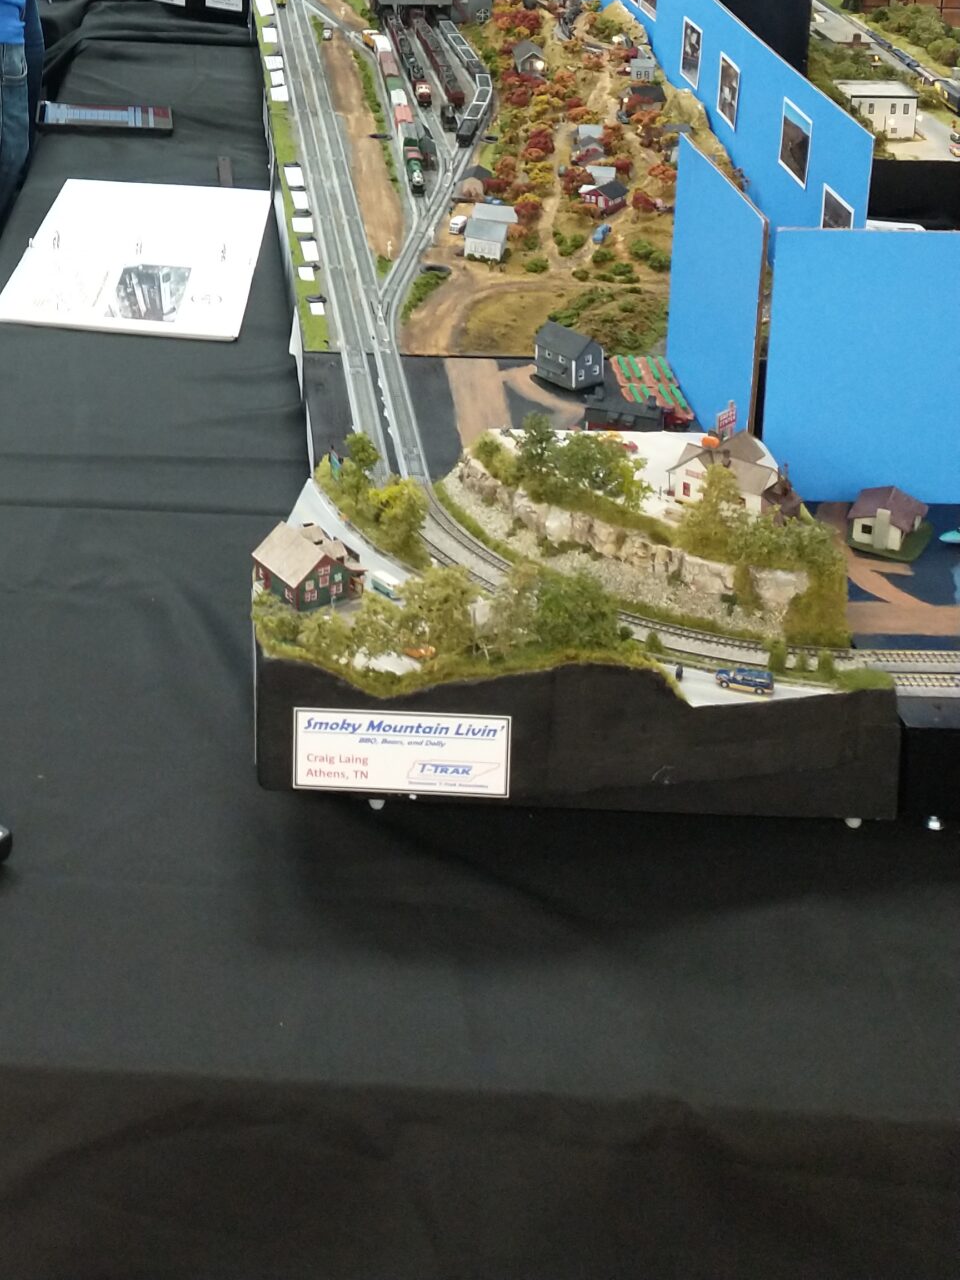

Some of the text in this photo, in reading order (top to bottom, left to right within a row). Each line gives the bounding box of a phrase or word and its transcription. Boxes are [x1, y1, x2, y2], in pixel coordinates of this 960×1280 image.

[304, 717, 505, 737] Smoky Mountain Livin'
[306, 753, 369, 766] Craig Laing
[306, 767, 369, 780] Athens, TN
[418, 762, 473, 776] T-TRAK
